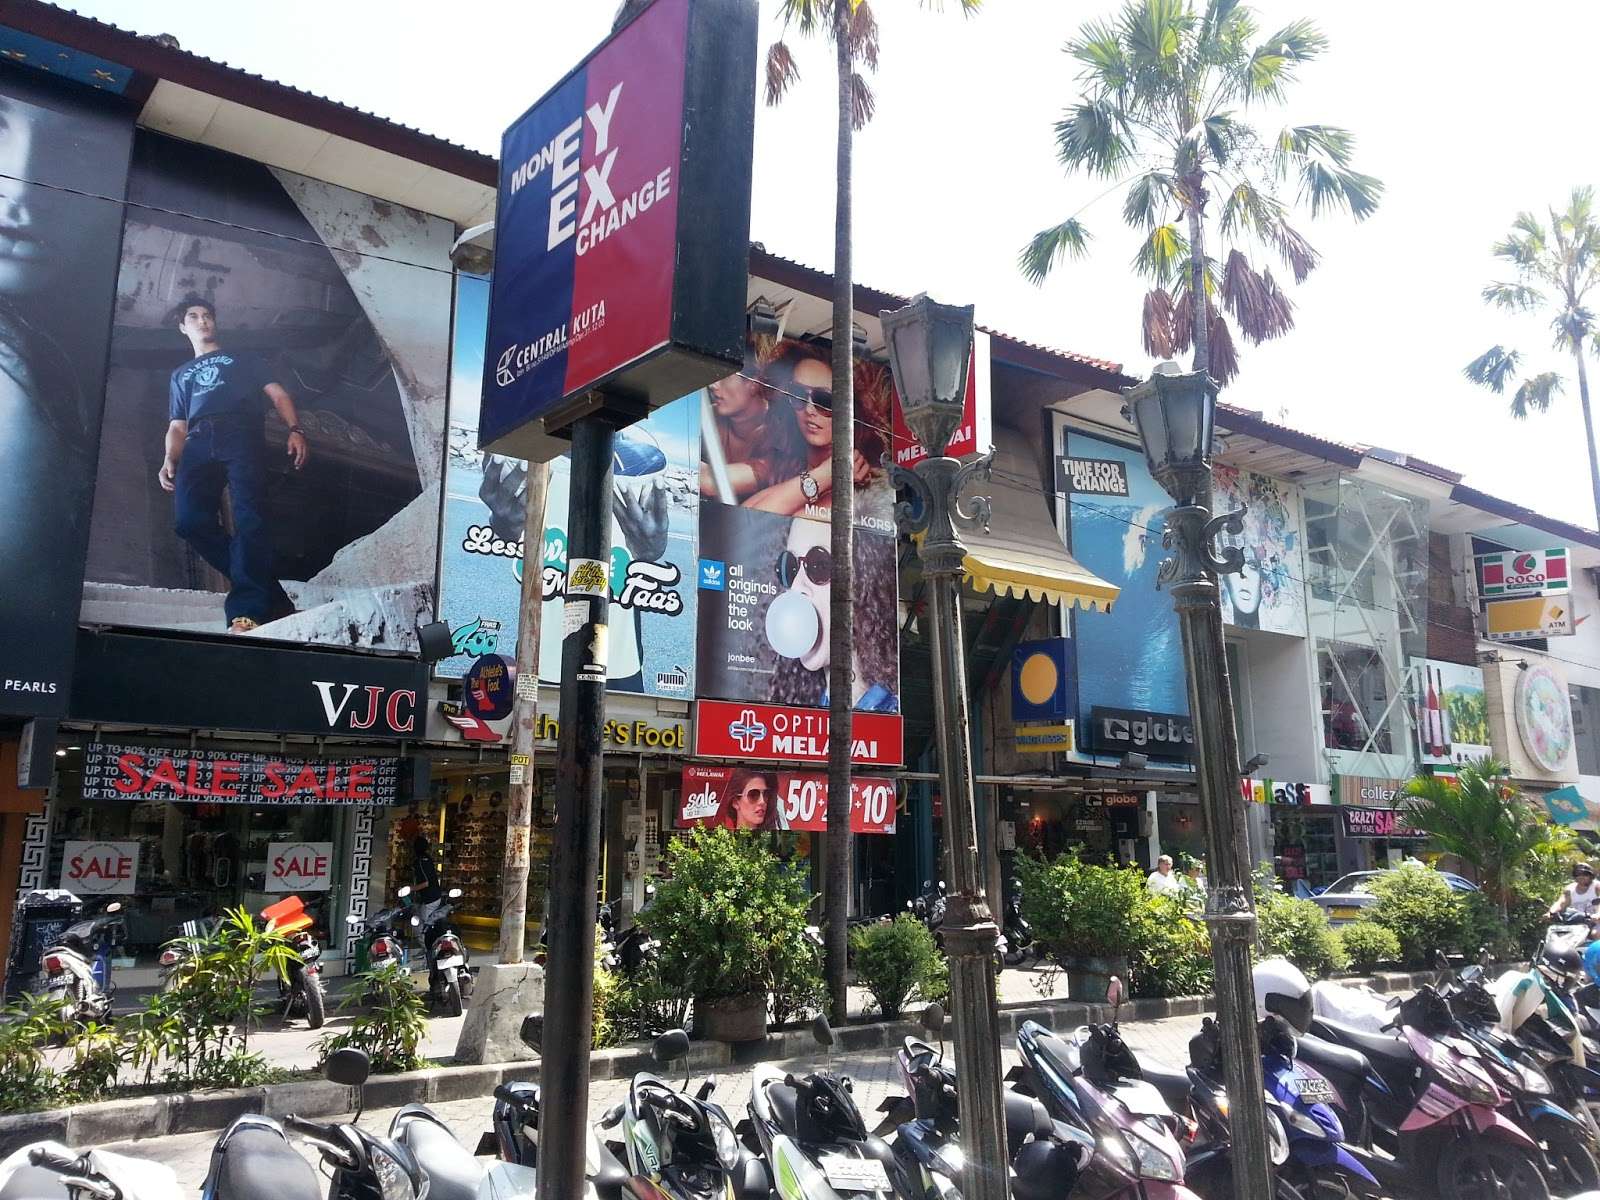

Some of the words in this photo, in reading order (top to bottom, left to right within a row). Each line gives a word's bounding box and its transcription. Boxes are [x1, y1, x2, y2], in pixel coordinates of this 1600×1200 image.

[511, 81, 624, 195] MONEY
[547, 146, 671, 257] EXCHANGE
[516, 324, 567, 368] CENTRAL
[573, 299, 606, 335] KUTA
[897, 425, 972, 464] MELAI
[1062, 459, 1094, 477] TIME
[1094, 462, 1120, 479] FOR
[1073, 474, 1127, 494] CHANGE
[861, 516, 891, 531] KORS
[729, 564, 743, 577] all
[1505, 573, 1546, 584] COCO
[619, 560, 682, 616] Faas
[729, 579, 777, 595] originals
[728, 590, 758, 605] have
[728, 603, 748, 616] the
[728, 617, 753, 631] look
[1548, 621, 1566, 629] ATM
[727, 652, 756, 663] jonbee
[4, 679, 57, 694] PEARLS
[657, 672, 684, 685] PUMA
[312, 680, 417, 732] VJC
[635, 720, 685, 749] Foot
[1132, 717, 1194, 746] globe
[88, 743, 103, 752] UP
[106, 744, 120, 753] TO
[148, 748, 170, 757] OFF
[173, 749, 188, 758] UP
[191, 750, 204, 759] TO
[207, 751, 227, 760] 90%
[230, 752, 249, 761] OFF
[772, 735, 878, 759] MELAI
[87, 754, 102, 763] UP
[379, 767, 397, 775] OFF
[86, 765, 101, 774] UP
[104, 766, 118, 775] TO
[378, 776, 397, 785] OFF
[114, 752, 241, 797] SALE
[259, 761, 376, 800] SALE
[84, 777, 100, 786] UP
[377, 786, 397, 795] OFF
[686, 782, 717, 810] sale
[83, 788, 98, 797] UP
[101, 788, 116, 798] TO
[377, 797, 396, 805] OFF
[1106, 793, 1138, 806] globe
[1349, 811, 1375, 824] CRAZY
[68, 856, 133, 878] SALE
[272, 856, 328, 877] SALE
